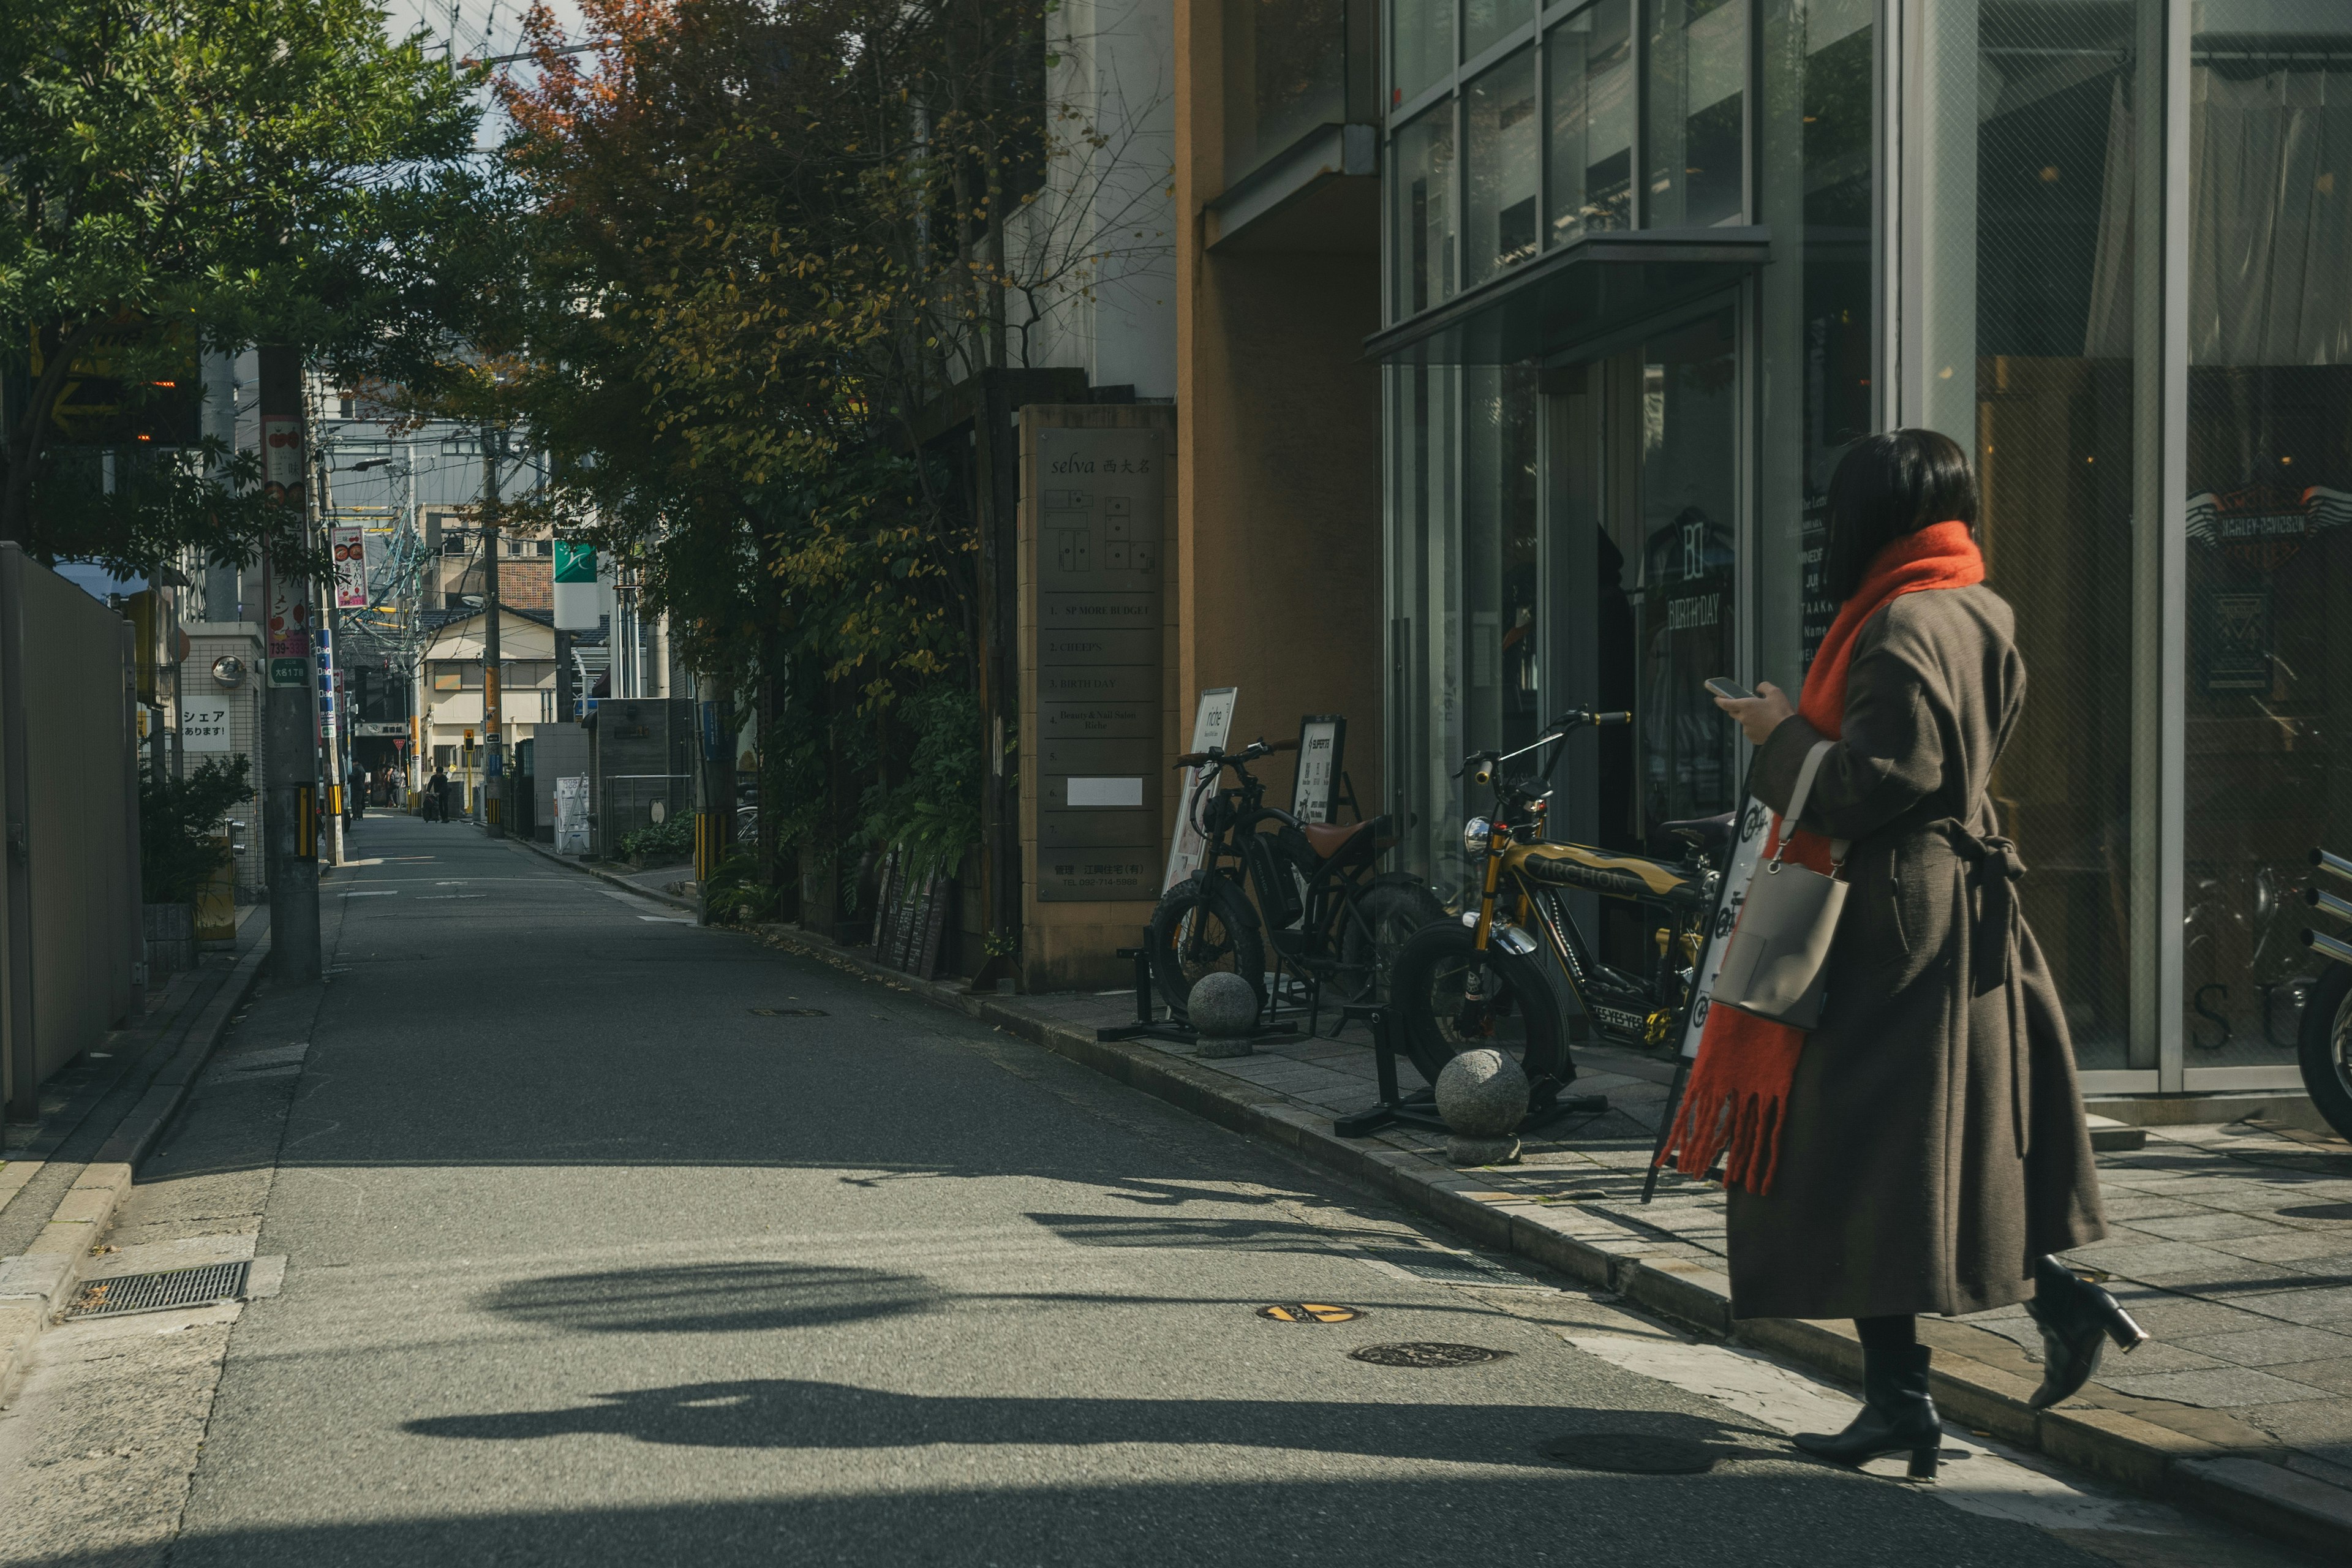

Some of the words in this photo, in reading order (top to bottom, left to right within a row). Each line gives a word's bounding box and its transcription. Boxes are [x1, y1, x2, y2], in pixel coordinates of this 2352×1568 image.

[1052, 452, 1095, 473] selva
[1103, 459, 1150, 473] 西大名
[1050, 606, 1057, 615] 1.
[1065, 606, 1077, 615] SP
[1079, 606, 1108, 615] MORE
[1110, 606, 1149, 615] BUDGET
[1700, 593, 1720, 625] DAY
[1050, 643, 1057, 652] 2.
[1060, 643, 1102, 652] CHEEP'S
[1050, 679, 1057, 688] 3.
[1060, 679, 1091, 688] BIRTH
[1094, 679, 1116, 688] DAY
[184, 711, 224, 722] シェア
[1060, 710, 1087, 720] Beauty
[1088, 710, 1095, 719] &
[1097, 710, 1112, 719] Nail
[1114, 710, 1136, 719] Salon
[1085, 721, 1107, 729] Riche
[1055, 864, 1074, 875] 管理
